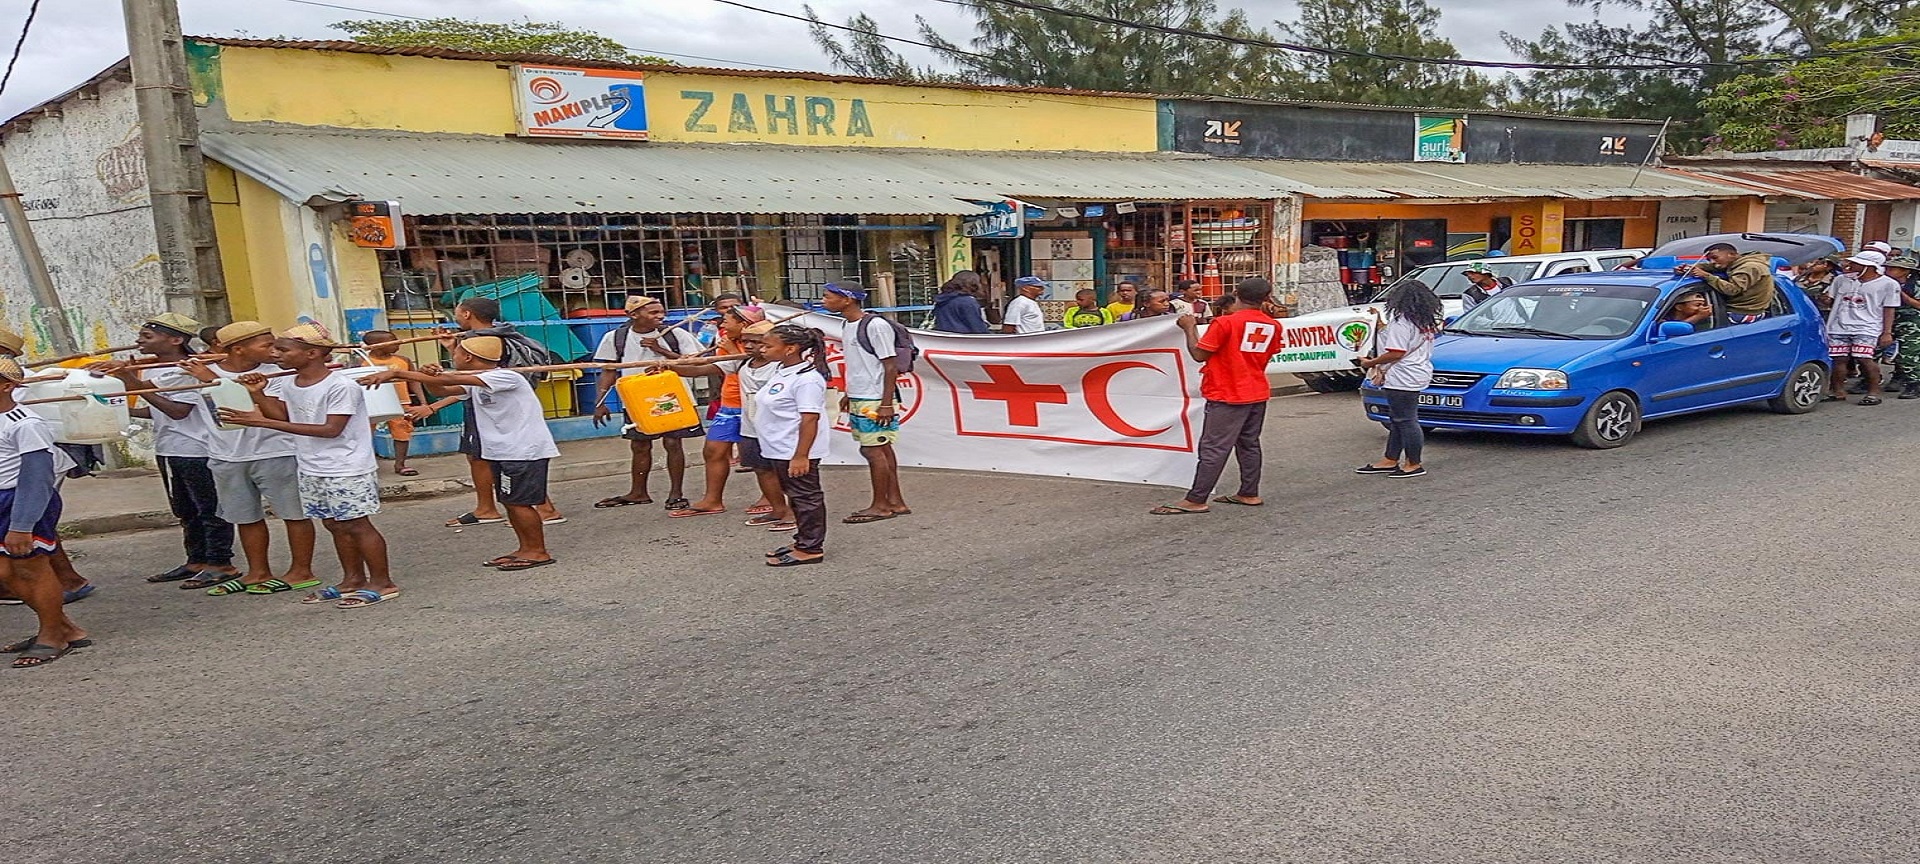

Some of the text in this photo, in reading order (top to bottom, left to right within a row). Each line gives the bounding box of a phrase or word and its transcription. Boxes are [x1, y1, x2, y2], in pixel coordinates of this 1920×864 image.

[680, 90, 874, 137] ZAHRA
[1518, 214, 1536, 249] SOA
[1286, 325, 1336, 349] AVOTRA
[1276, 350, 1337, 363] FORT-DAUPHIN
